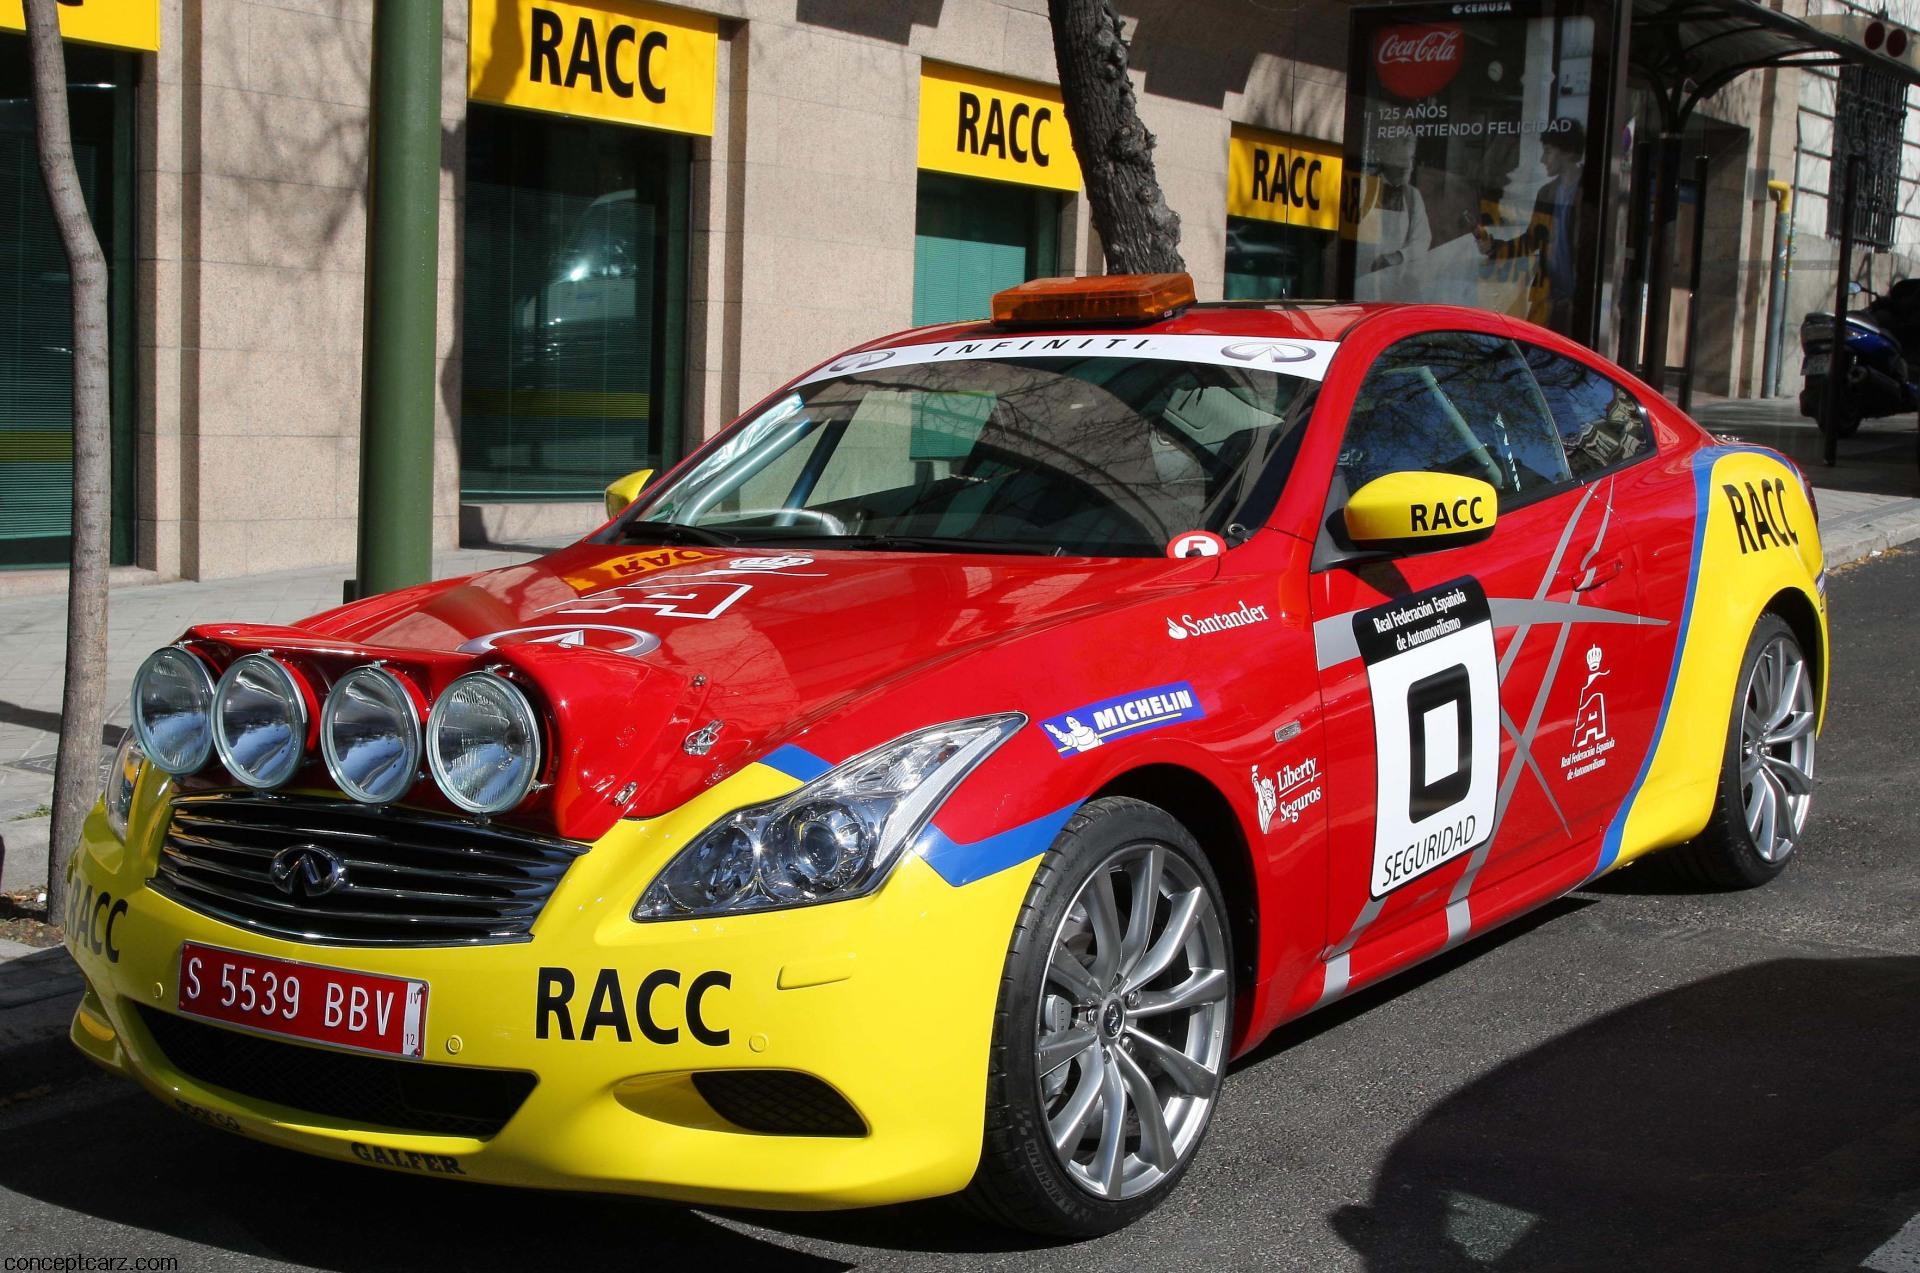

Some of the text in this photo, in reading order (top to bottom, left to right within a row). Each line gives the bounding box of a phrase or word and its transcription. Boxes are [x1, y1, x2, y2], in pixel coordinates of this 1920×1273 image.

[1465, 3, 1512, 13] CEMUSA
[530, 7, 668, 104] RACC
[1378, 31, 1459, 64] Coca-Cola
[957, 91, 1051, 167] RACC
[1377, 120, 1572, 138] REPARTIENDO FELICIDAD
[1379, 104, 1448, 120] 125 AÑOS
[1252, 148, 1322, 211] RACC
[934, 338, 1149, 356] INFINITI
[1410, 496, 1484, 532] RACC
[1722, 477, 1799, 555] RACC
[1181, 600, 1269, 636] Santander
[1372, 588, 1467, 634] Real Federación Española
[1396, 617, 1461, 651] de Automovilismo
[1092, 690, 1193, 731] MICHELIN
[1407, 662, 1473, 824] 0
[1277, 757, 1317, 792] Liberty
[1280, 786, 1321, 823] Seguros
[1382, 815, 1476, 887] SEGURIDAD
[186, 957, 395, 1036] S 5539 BBV
[536, 966, 732, 1047] RACC
[406, 1033, 416, 1046] 12
[351, 1141, 466, 1175] GALFER
